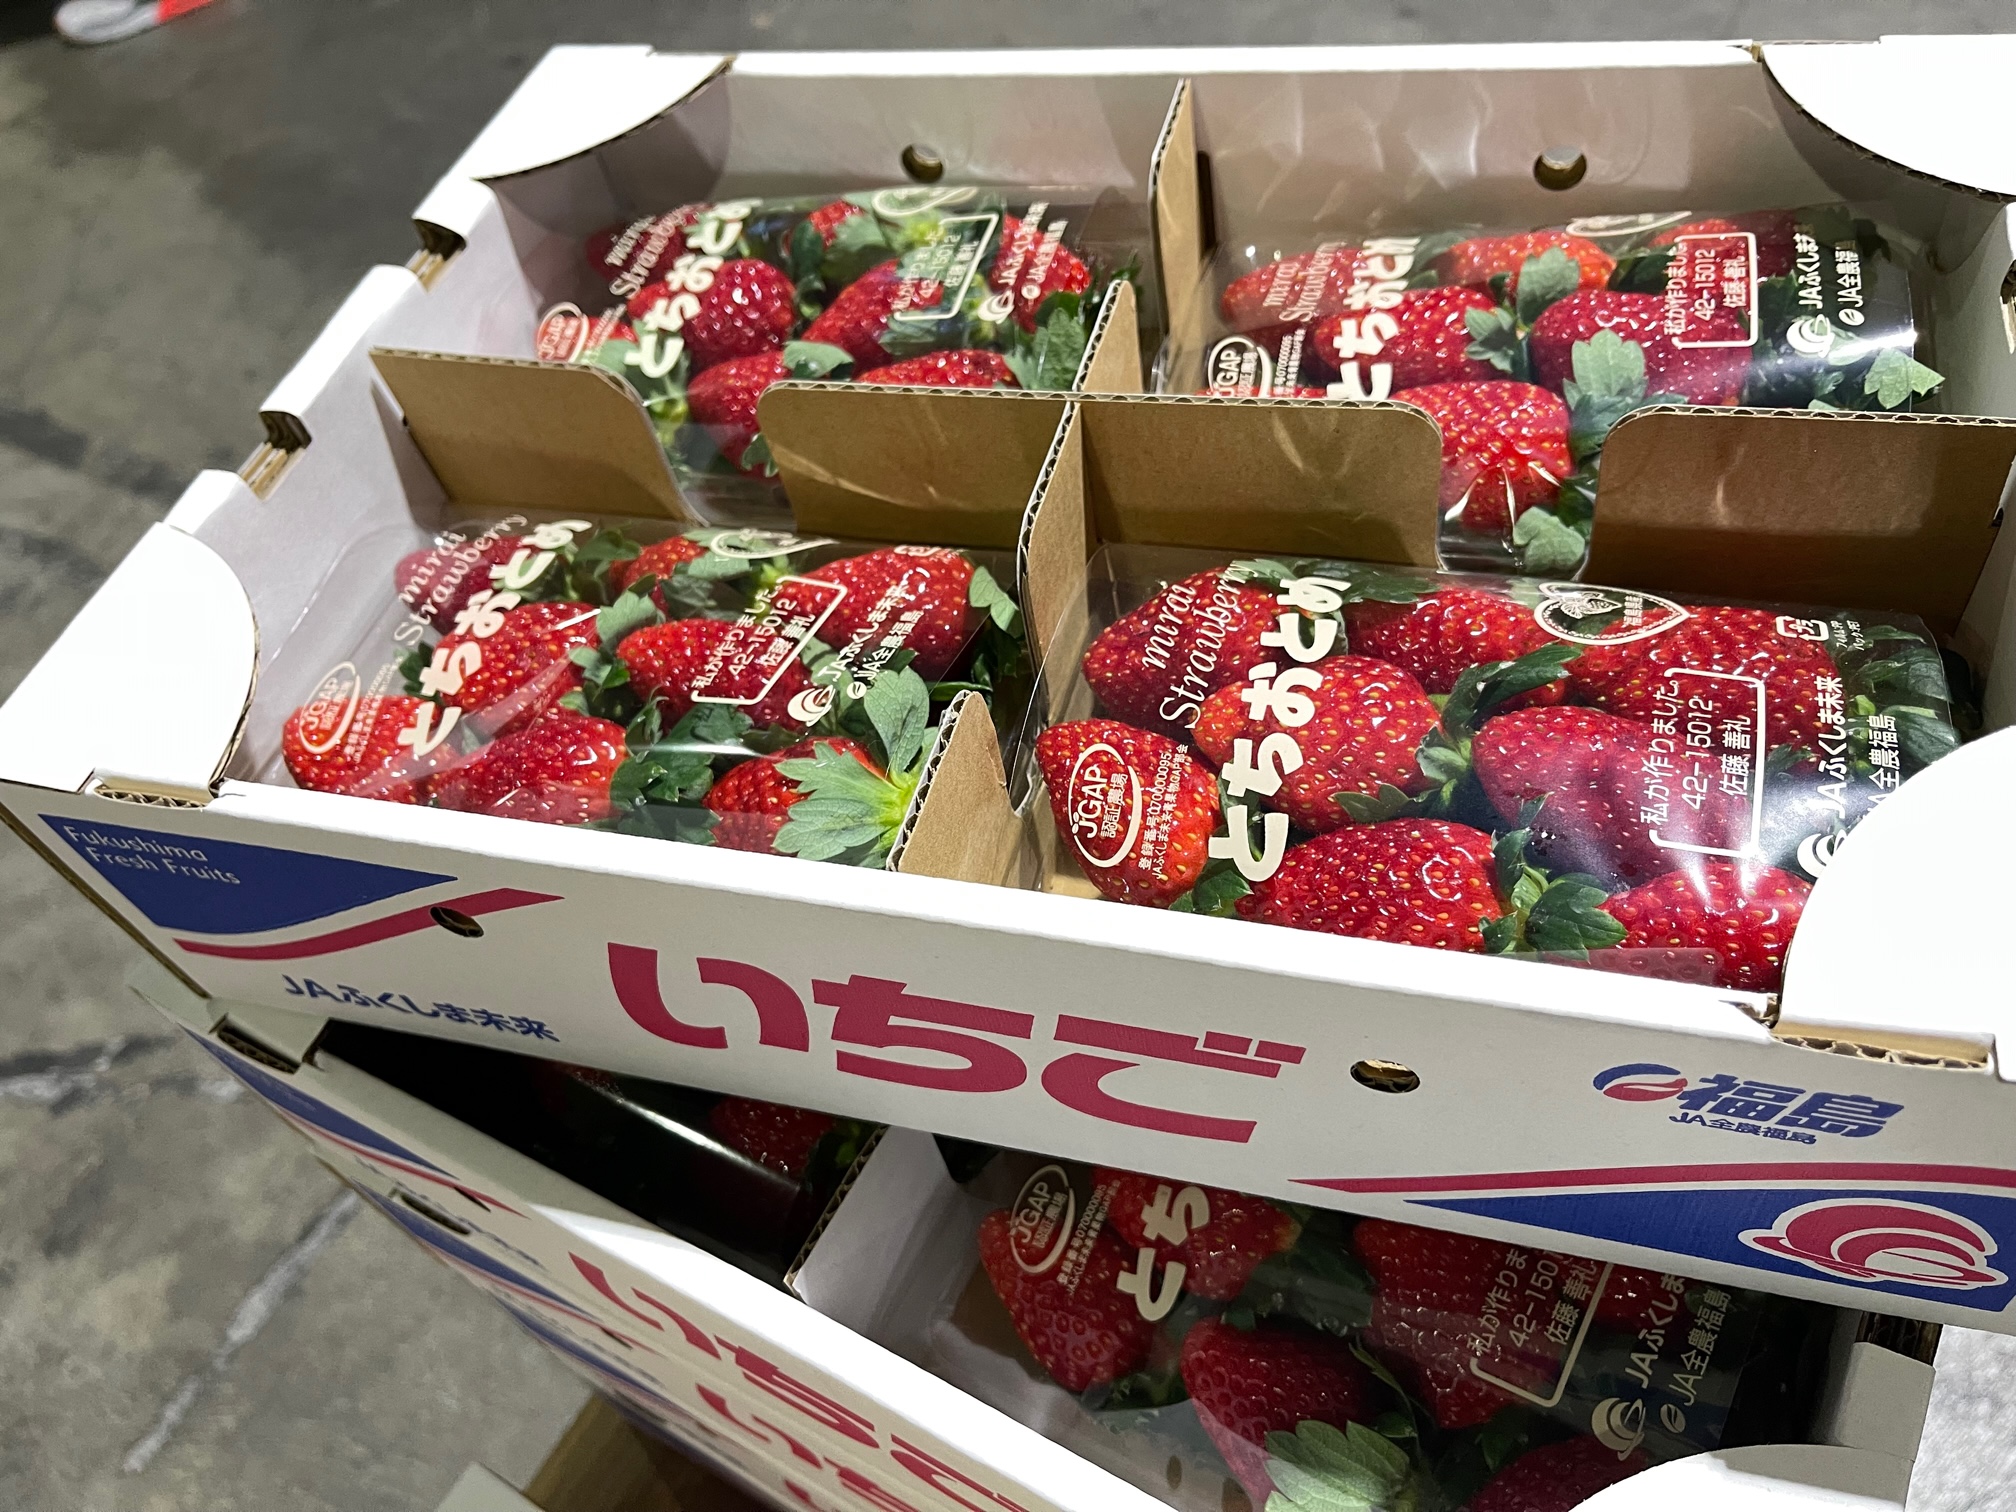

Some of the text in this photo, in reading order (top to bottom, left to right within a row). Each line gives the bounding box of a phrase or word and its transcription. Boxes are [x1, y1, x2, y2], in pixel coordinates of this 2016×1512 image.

[624, 198, 763, 378] とちおとめ
[1693, 248, 1717, 322] 42-15012
[394, 514, 528, 647] Strawberry
[397, 519, 593, 757] とちおとめ
[728, 598, 798, 677] 42-15012
[1141, 582, 1197, 671] mirai
[1158, 558, 1259, 730] Strawberry
[1208, 575, 1352, 883] とちおとめ
[1640, 679, 1680, 827] 私が作りました。
[1680, 698, 1714, 811] 42-15012
[1718, 715, 1752, 798] 佐藤 善礼
[1813, 675, 1848, 820] JAふくしま未来
[63, 825, 209, 863] Fukushima
[1077, 764, 1108, 839] JGAP
[85, 846, 241, 886] Fresh Fruits
[281, 973, 561, 1043] JAふくしま未来
[606, 941, 1308, 1144] いちご
[1668, 1112, 1817, 1145] JA全農福島
[1676, 1073, 1905, 1138] 福島
[1016, 1181, 1052, 1244] JGAP
[1542, 1299, 1582, 1346] 佐藤
[1668, 1287, 1733, 1407] JA全農福島
